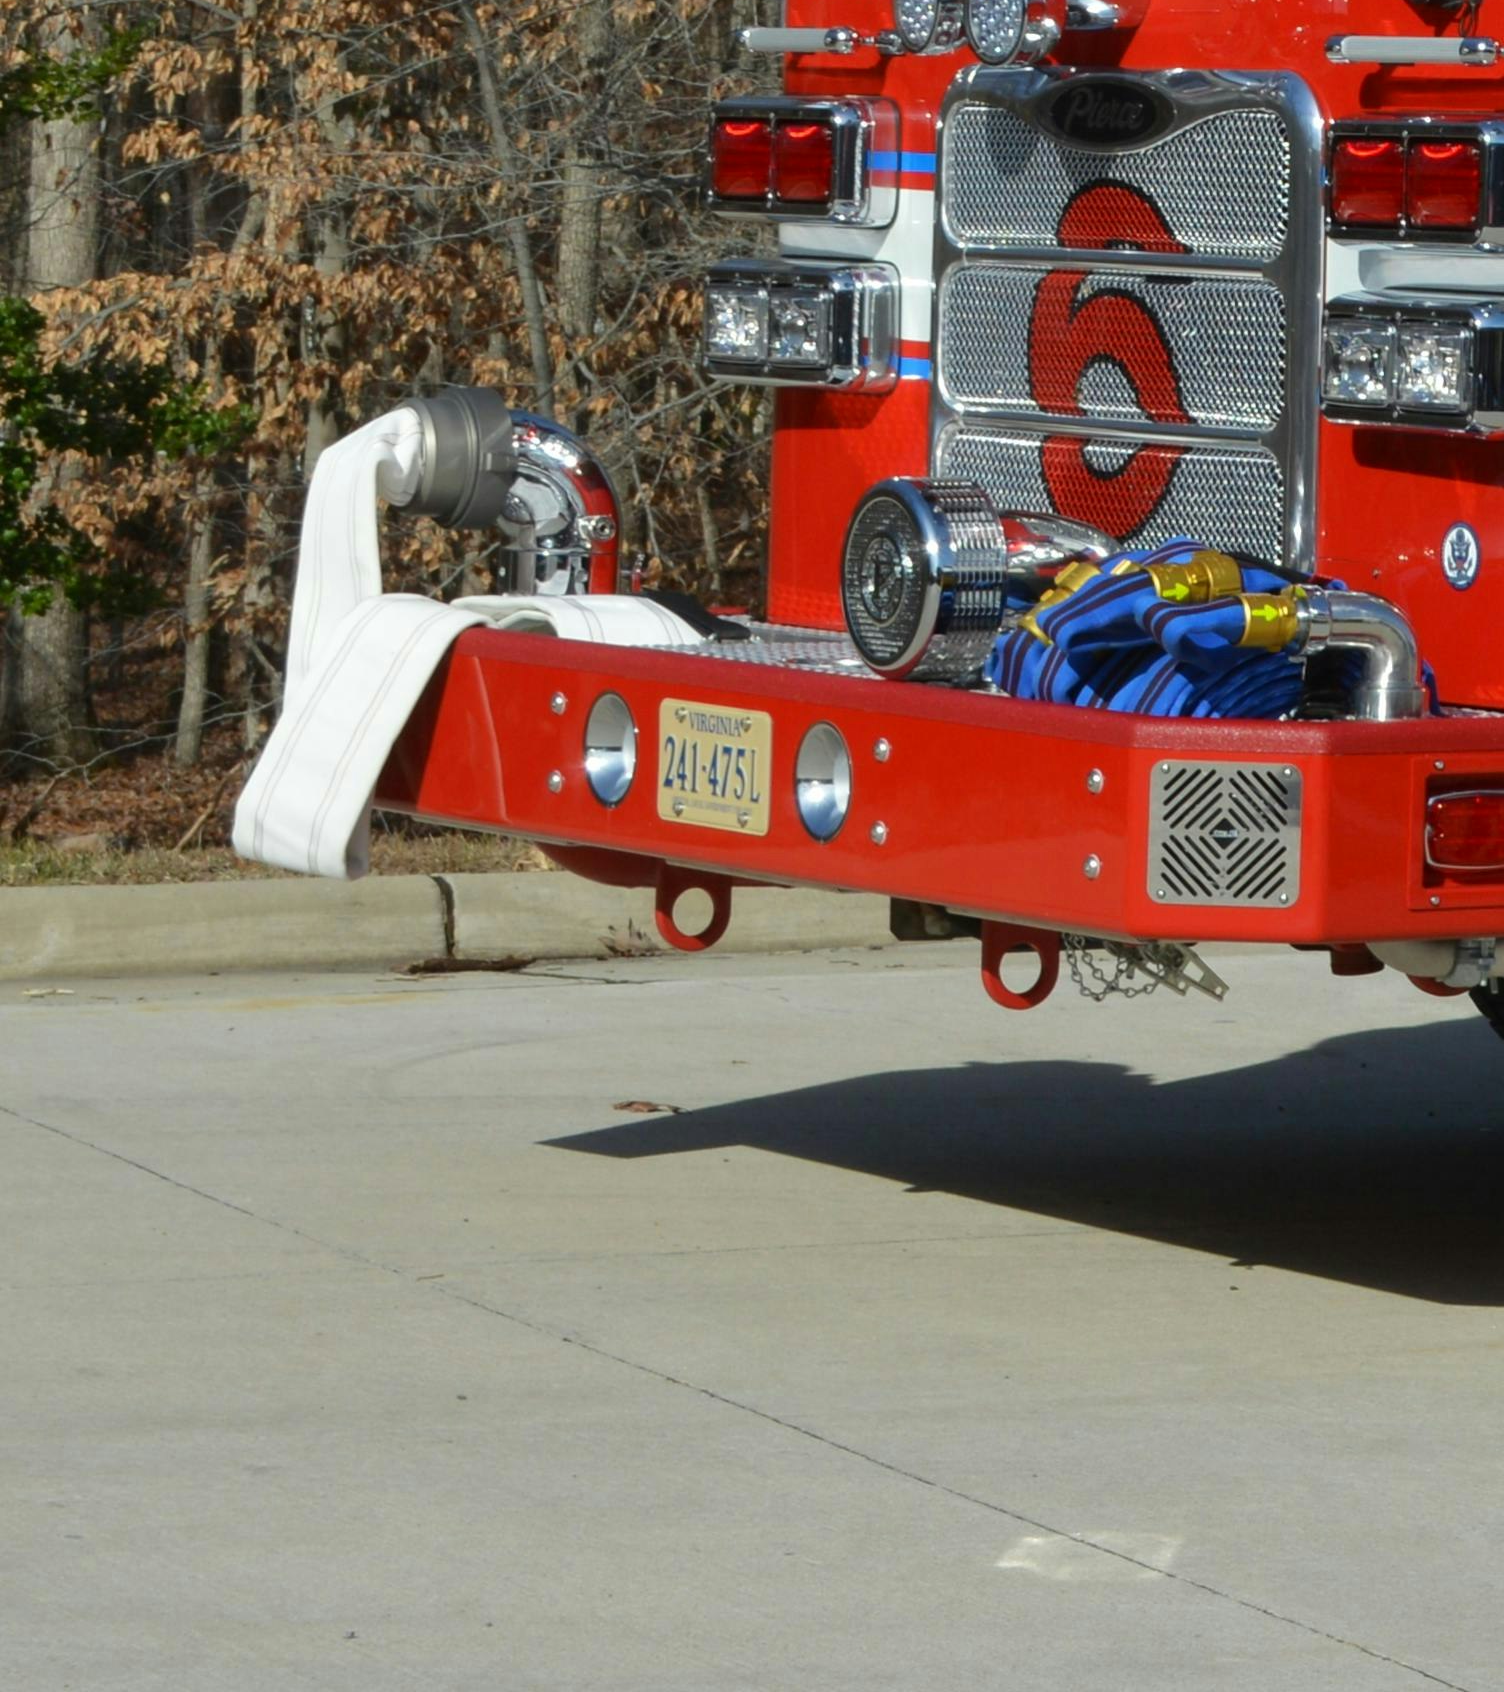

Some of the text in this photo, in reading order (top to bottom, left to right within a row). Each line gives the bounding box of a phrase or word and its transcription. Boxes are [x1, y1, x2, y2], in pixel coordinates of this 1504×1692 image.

[1029, 179, 1191, 539] 6
[688, 711, 742, 738] VIRGINIA
[663, 735, 761, 804] 241-475L
